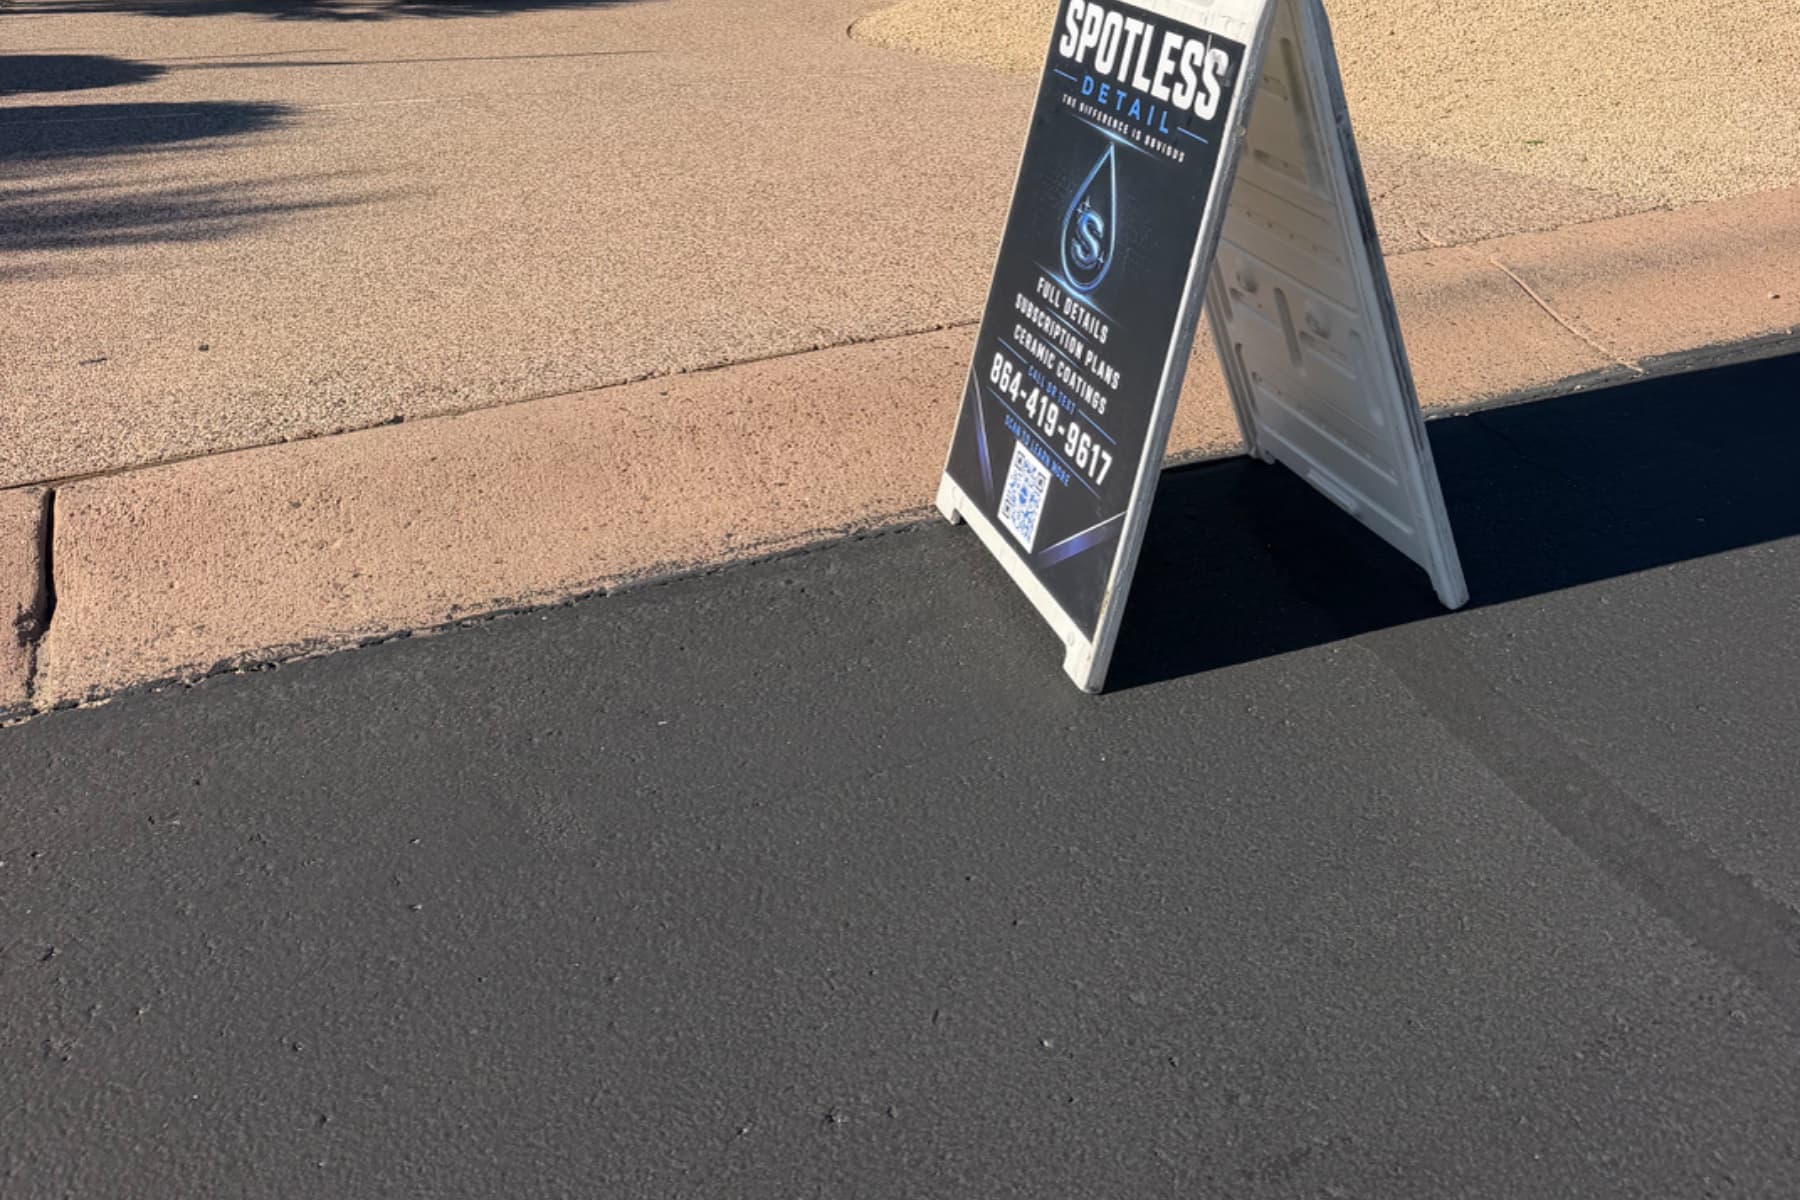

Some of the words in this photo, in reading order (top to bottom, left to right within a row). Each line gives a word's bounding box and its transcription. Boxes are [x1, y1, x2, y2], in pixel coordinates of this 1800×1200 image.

[1062, 93, 1077, 109] THE
[1079, 102, 1129, 135] DIFFERENCE
[1131, 128, 1141, 141] IS
[1144, 134, 1185, 163] OBVIOUS
[1081, 75, 1169, 134] DETAIL
[1014, 292, 1084, 360] SUBSCRIPTION
[1084, 349, 1120, 390] PLANS
[1036, 276, 1060, 309] FULL
[1063, 297, 1109, 345] DETAILS
[1013, 324, 1056, 370] CERAMIC
[1056, 360, 1107, 415] COATINGS
[1027, 365, 1045, 388] CALL
[1045, 381, 1058, 398] OR
[1058, 391, 1076, 415] TEXT
[990, 352, 1113, 485] 864-419-9617
[1030, 440, 1051, 468] LEARN
[1050, 460, 1070, 488] MORE
